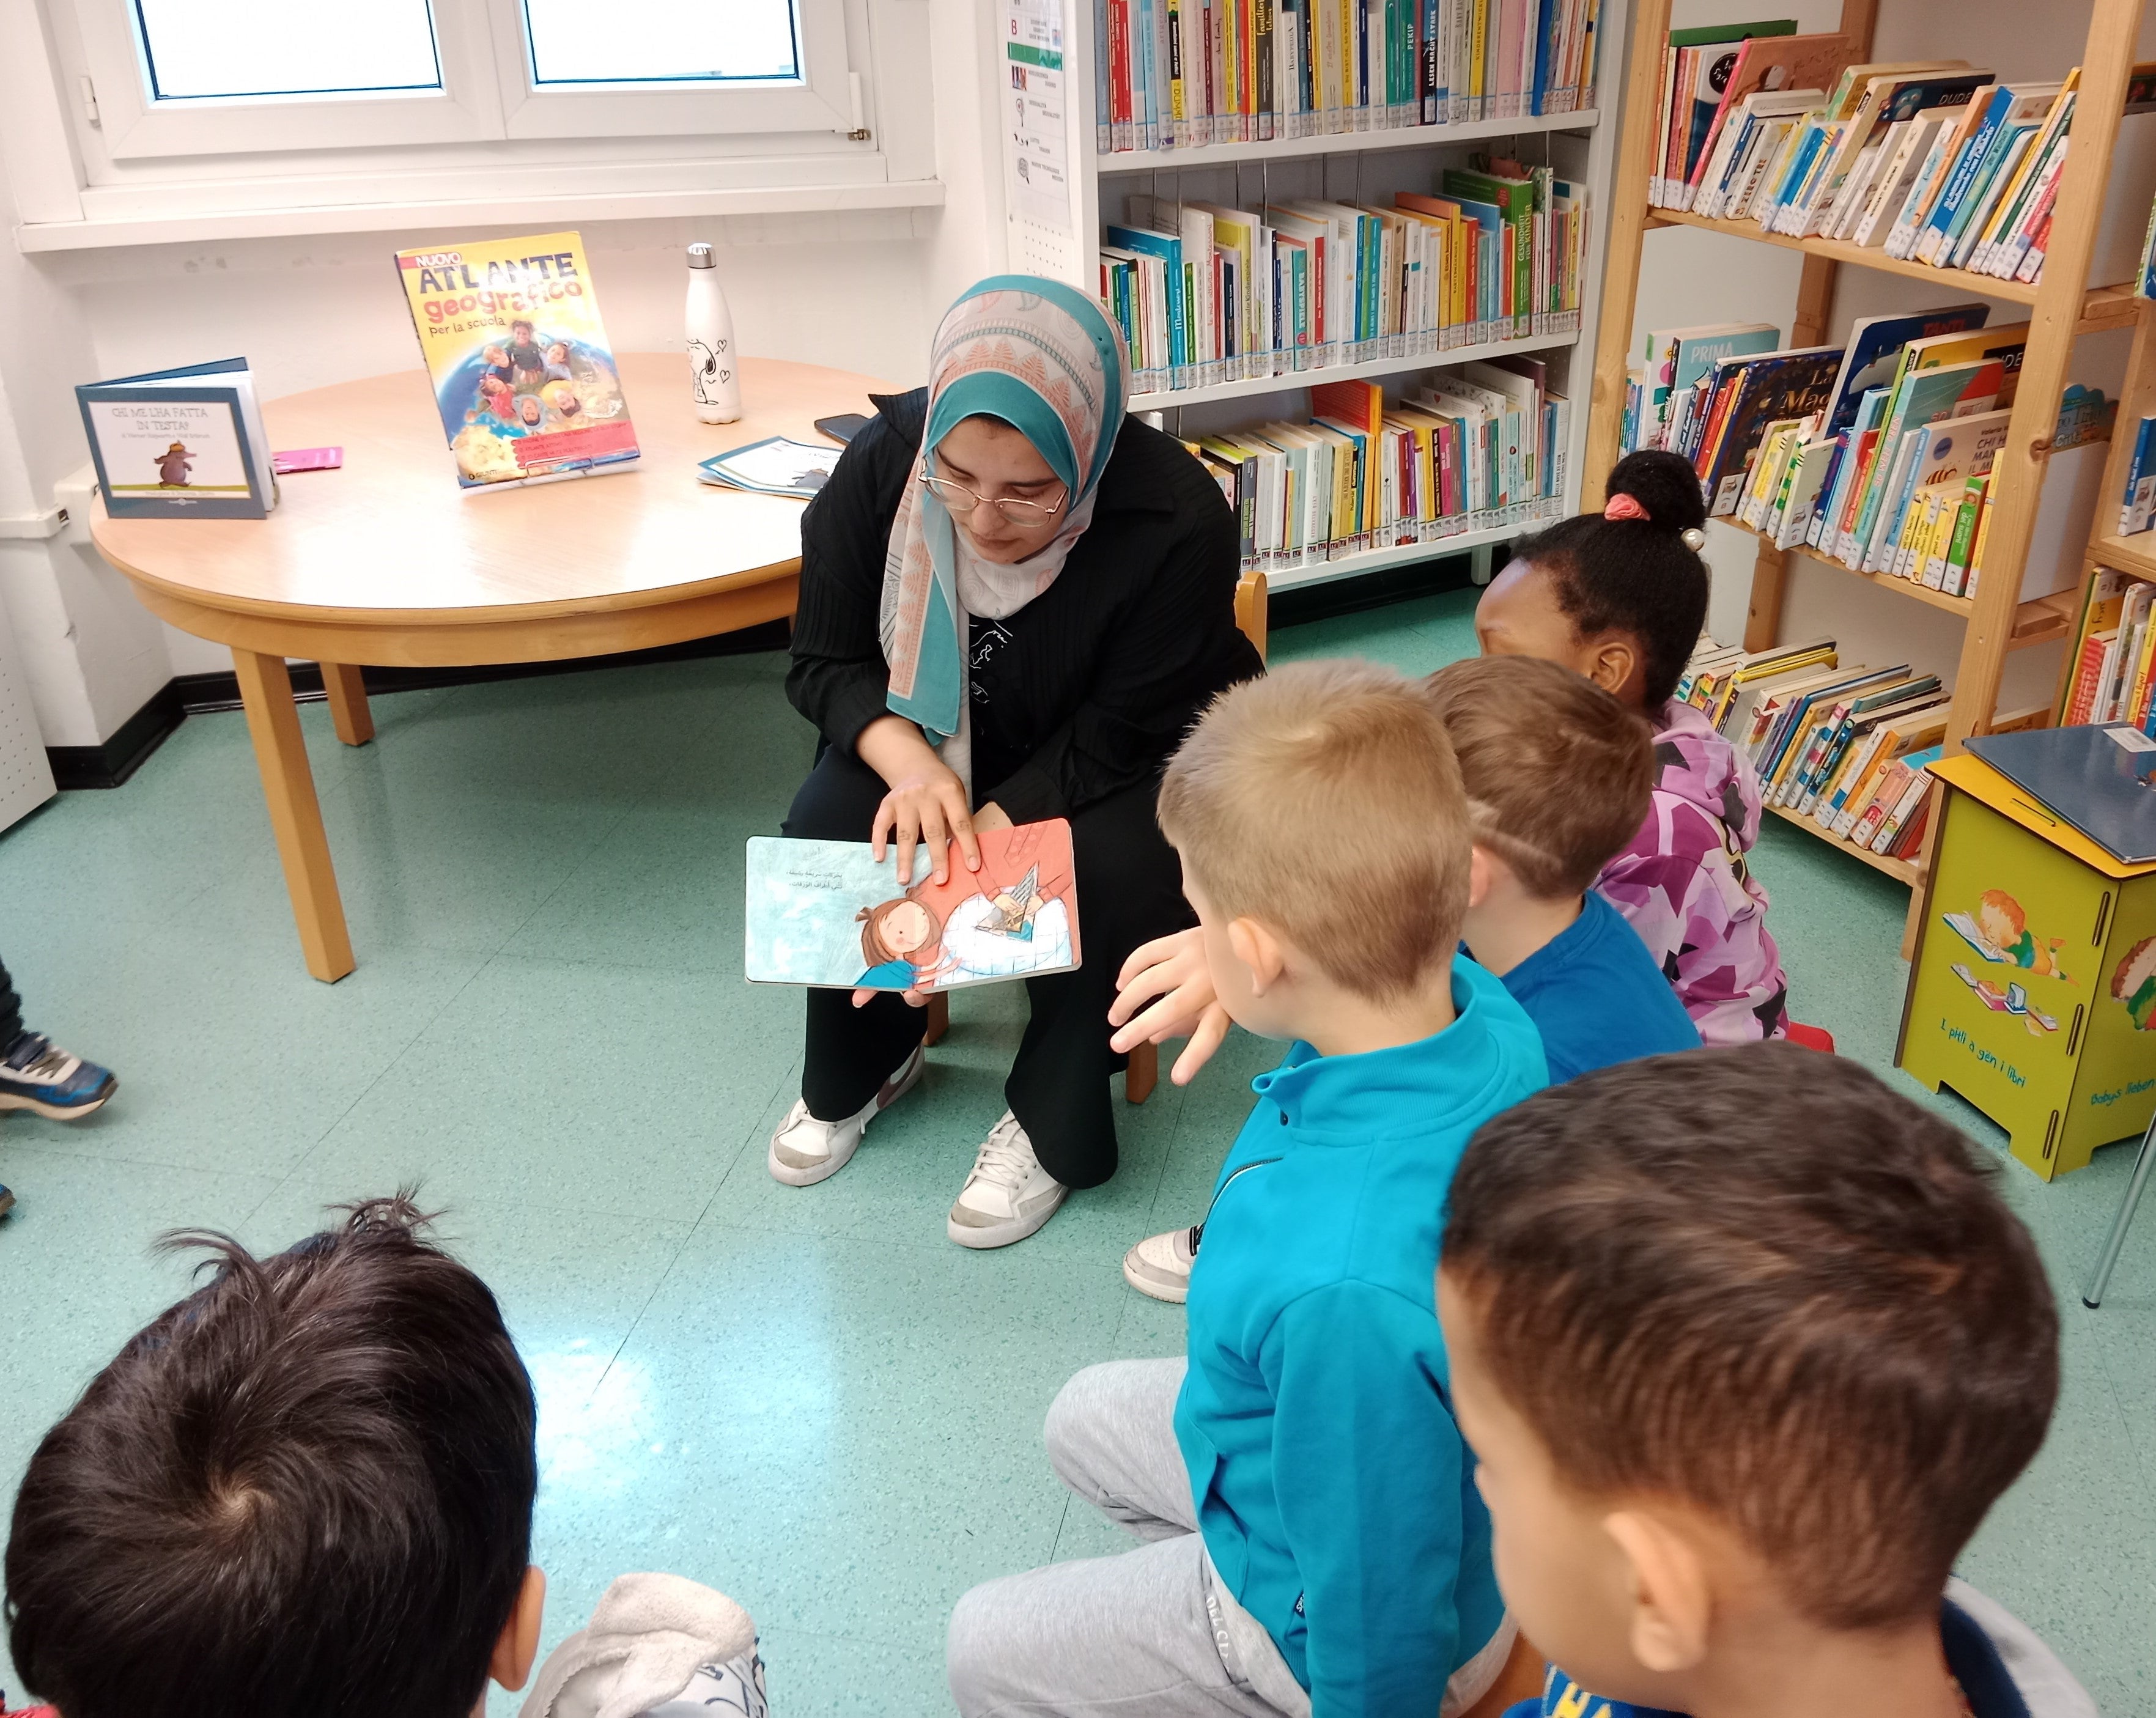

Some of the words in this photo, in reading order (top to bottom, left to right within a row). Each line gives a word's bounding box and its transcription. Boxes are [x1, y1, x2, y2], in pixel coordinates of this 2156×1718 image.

[1938, 91, 1973, 105] DUDE
[415, 251, 462, 268] NUOVO
[419, 252, 579, 295] ATLANTE
[423, 280, 583, 324] geografico
[428, 325, 450, 338] per
[454, 321, 465, 333] la
[467, 315, 507, 331] scuola
[1690, 342, 1733, 364] PRIMA
[112, 408, 128, 418] CHI
[130, 408, 148, 418] ME
[172, 407, 209, 418] FATTA
[136, 421, 150, 430] IN
[1977, 438, 1996, 449] CHI
[1973, 450, 1995, 462] MAN
[1940, 1018, 1947, 1031] I
[1999, 1060, 2005, 1072] i
[2007, 1064, 2027, 1088] libri
[2090, 1089, 2122, 1107] Babys
[2125, 1078, 2156, 1096] lieben
